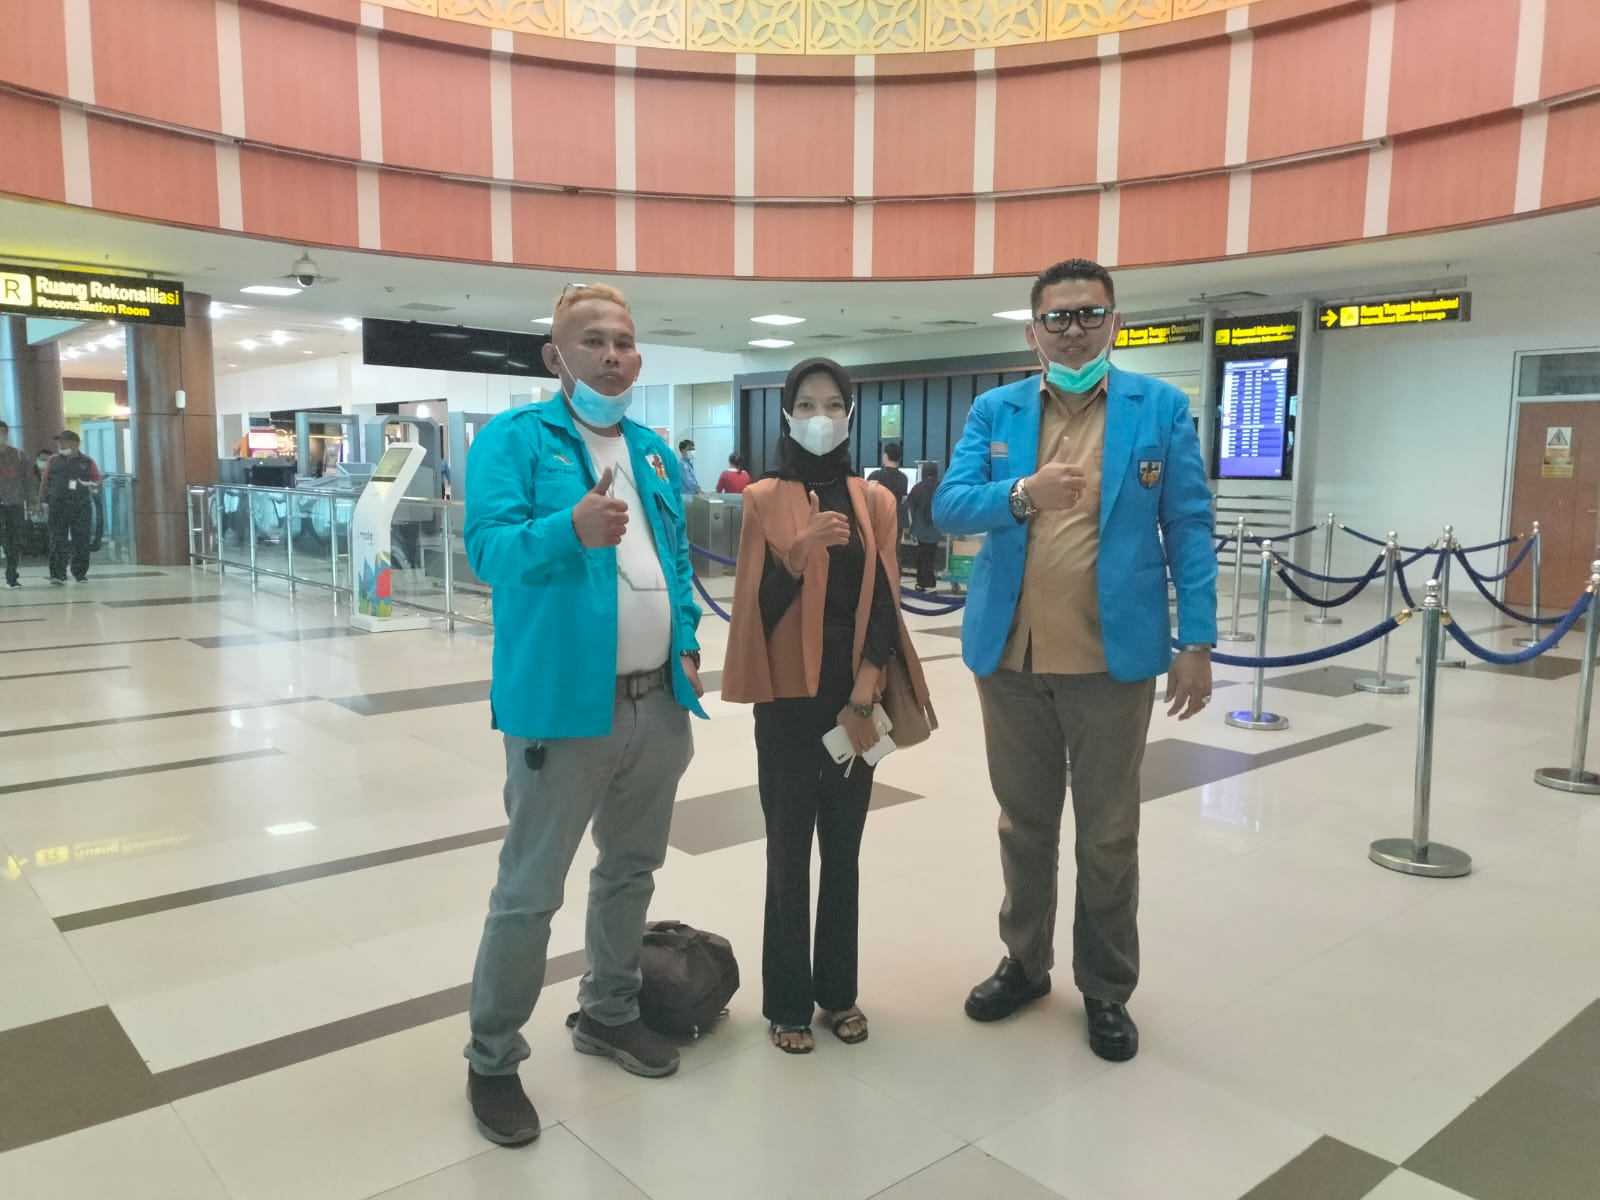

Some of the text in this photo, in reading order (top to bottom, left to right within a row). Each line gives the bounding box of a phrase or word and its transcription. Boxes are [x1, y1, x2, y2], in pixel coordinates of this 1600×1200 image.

[5, 279, 21, 299] R
[36, 276, 179, 305] Ruang Rekonsiliasi
[37, 297, 150, 317] Reconciliation Room
